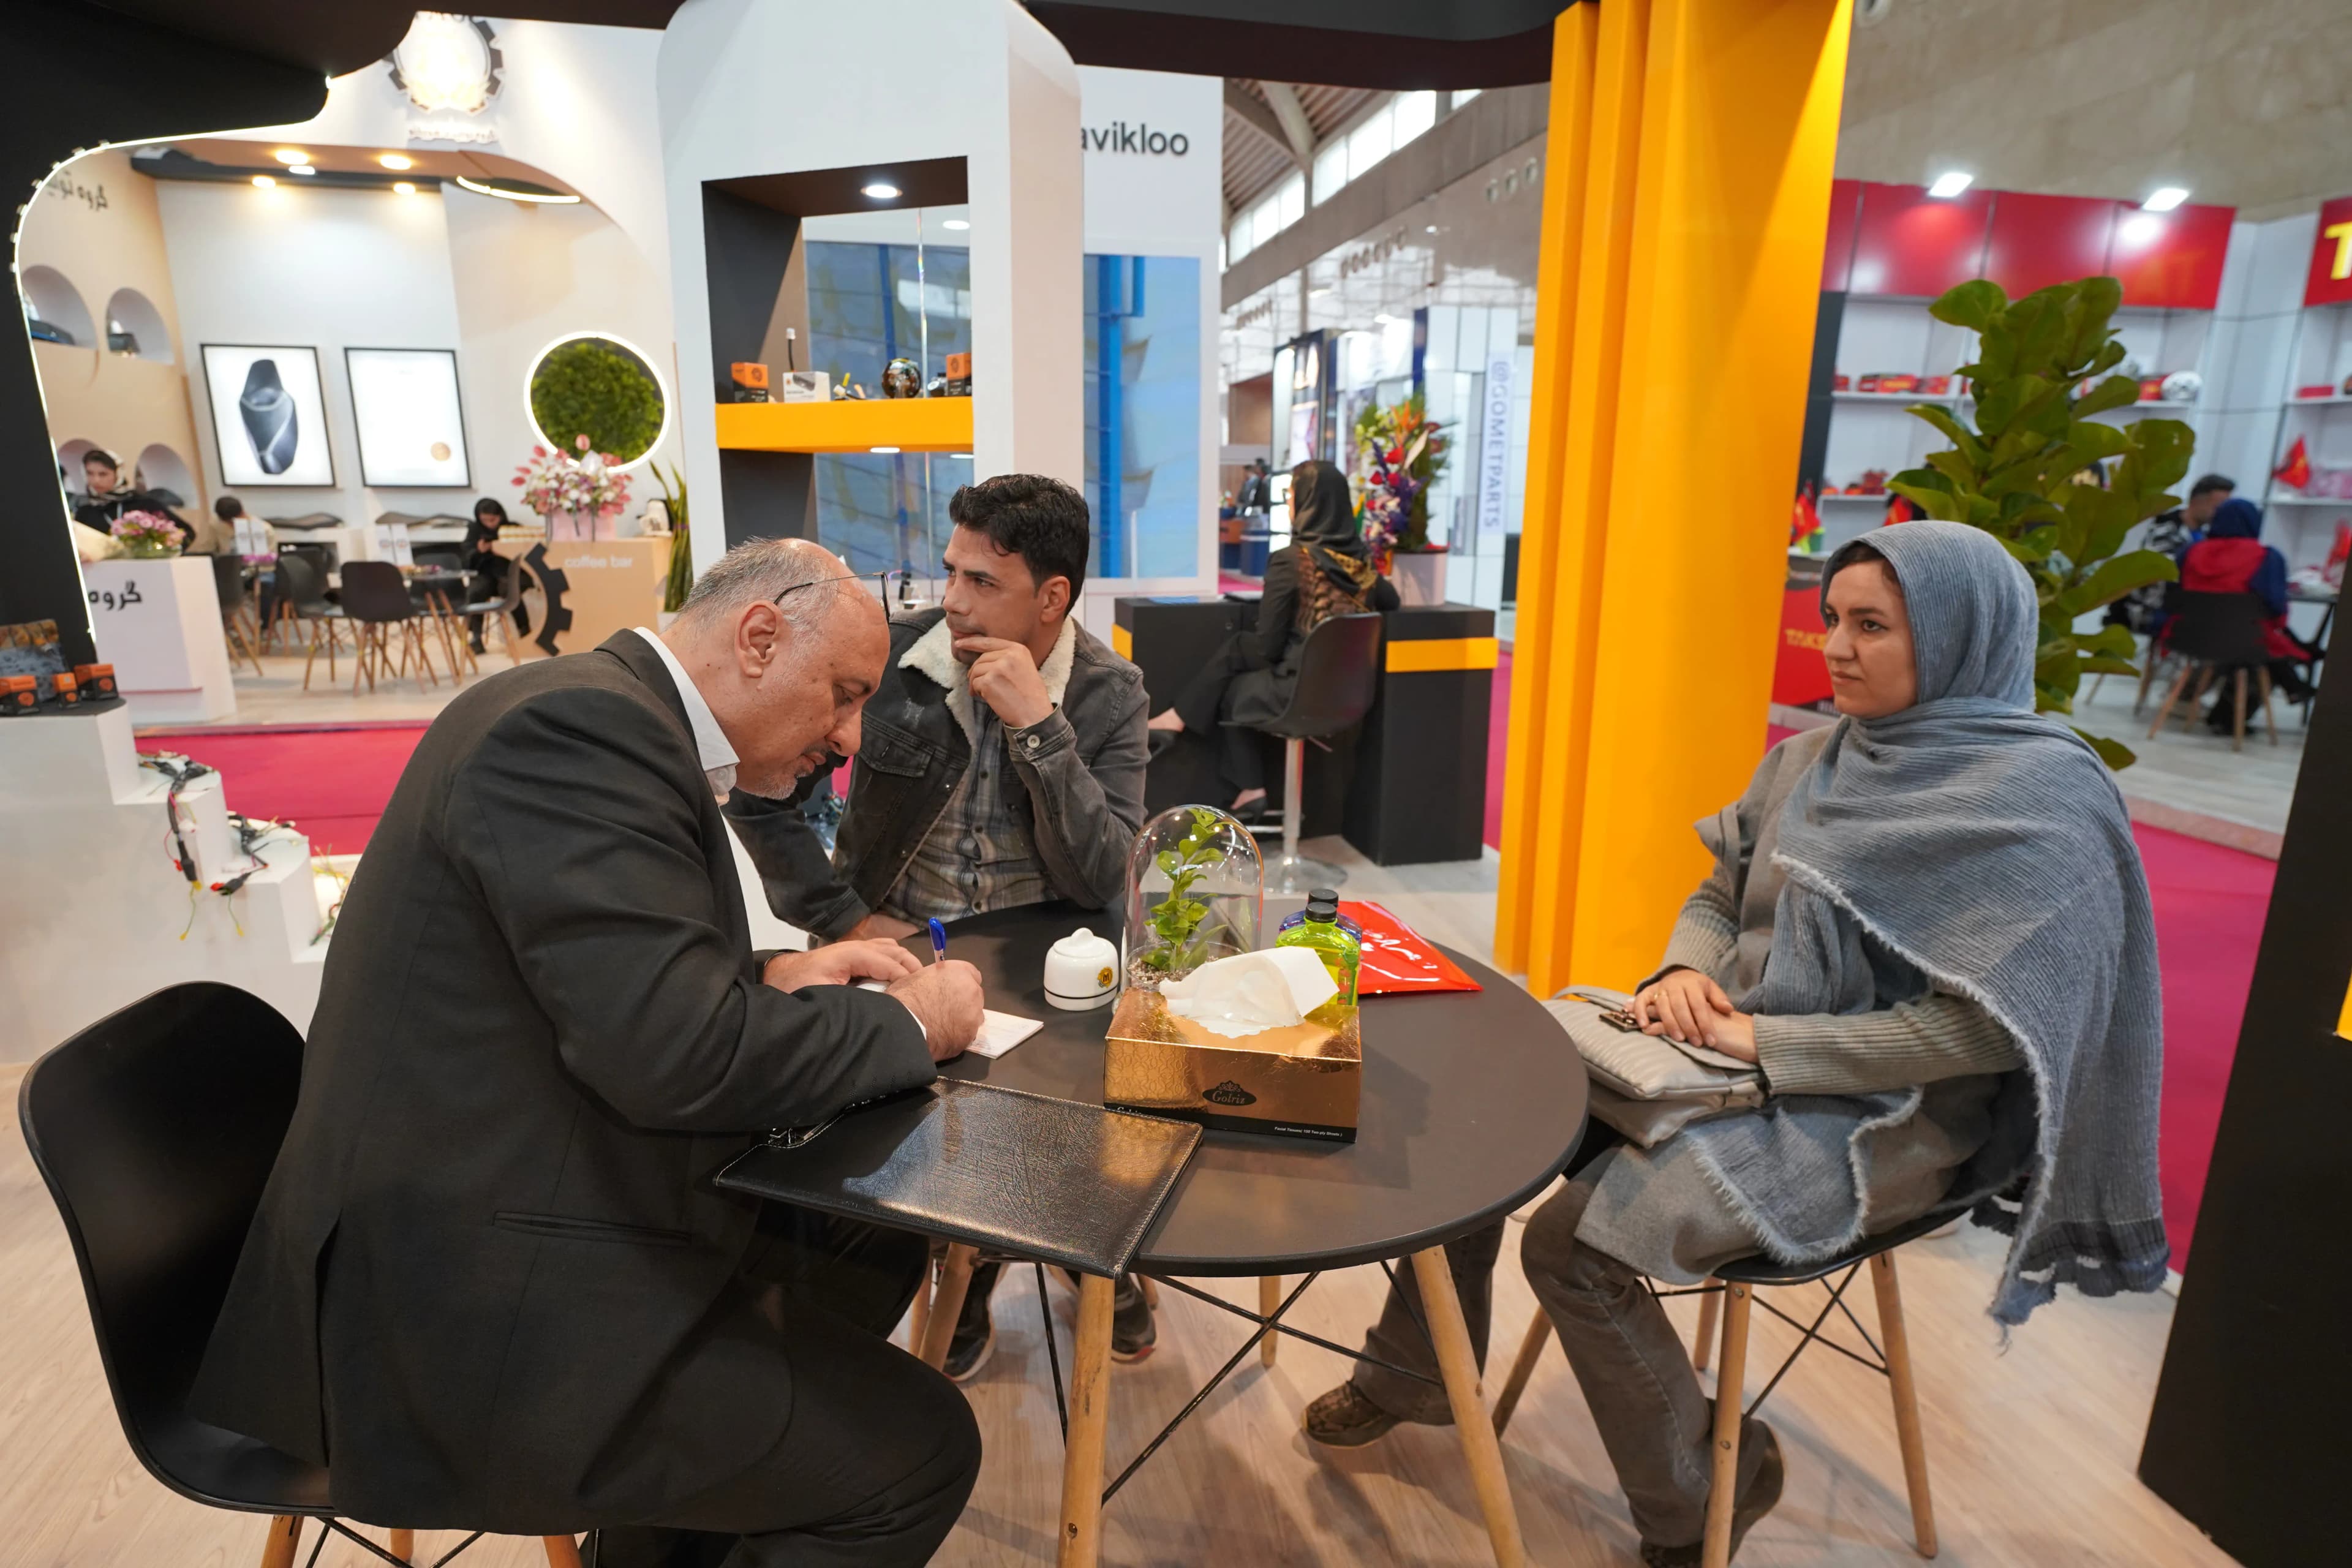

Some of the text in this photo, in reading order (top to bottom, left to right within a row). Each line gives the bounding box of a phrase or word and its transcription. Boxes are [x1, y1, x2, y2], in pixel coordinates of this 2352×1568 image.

[564, 554, 633, 568] coffee bar
[88, 580, 142, 611] گروه
[1213, 1090, 1246, 1104] Golriz
